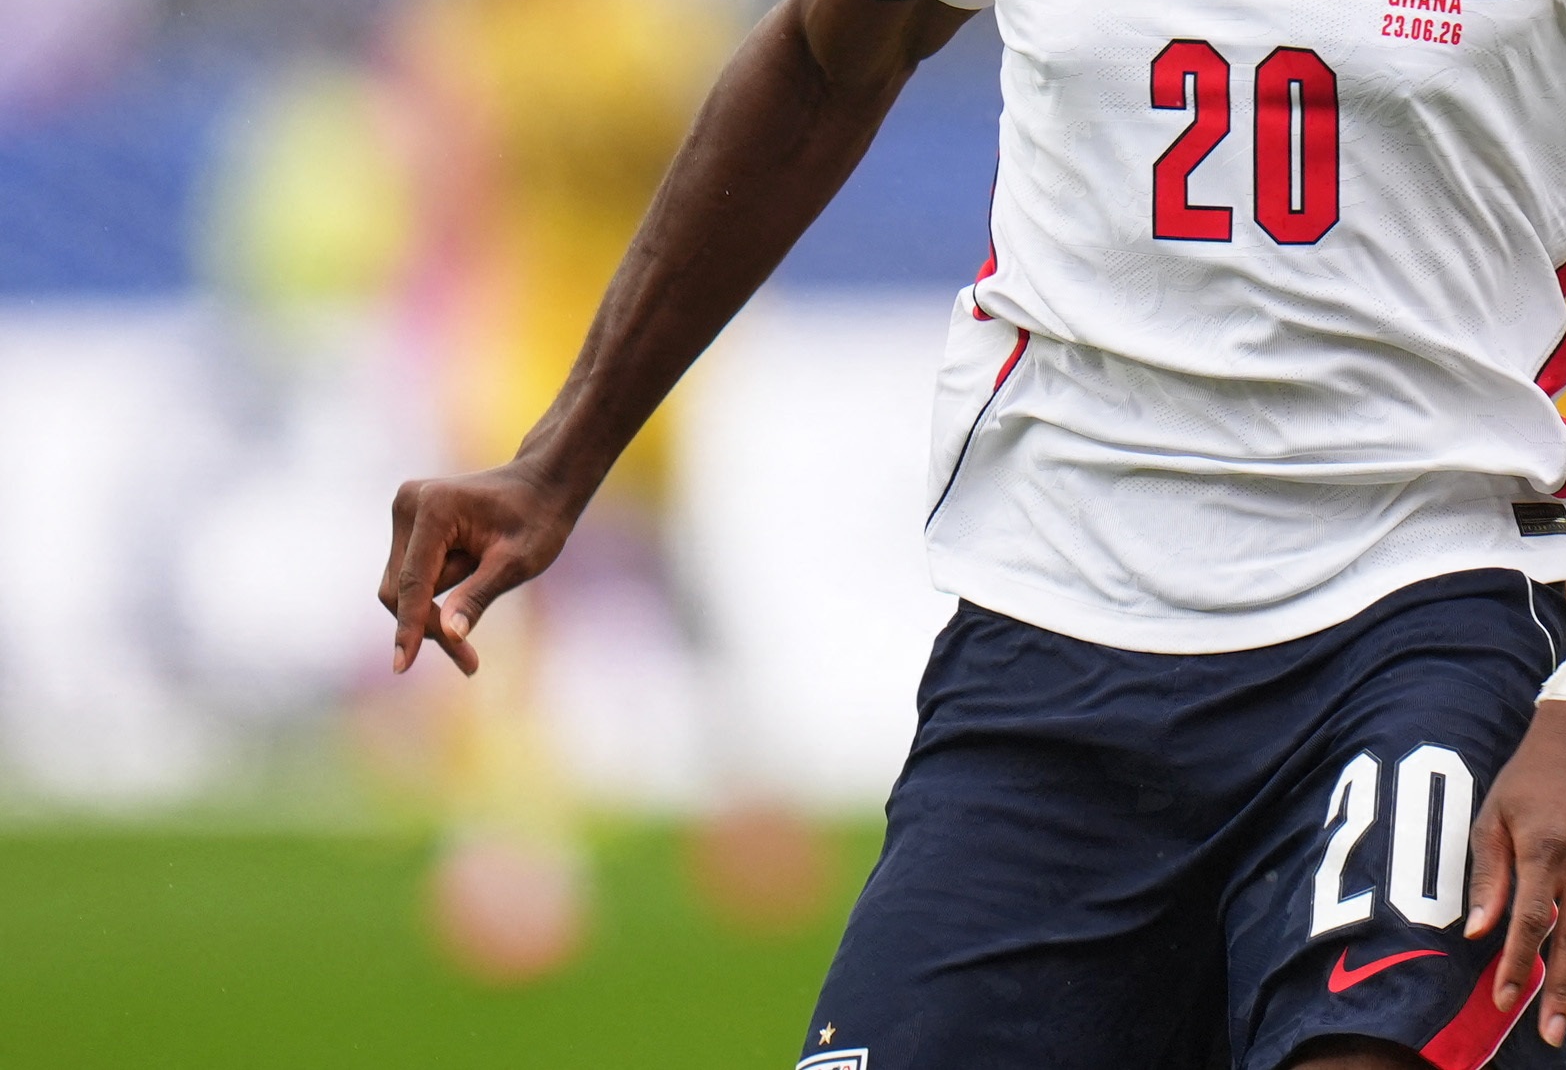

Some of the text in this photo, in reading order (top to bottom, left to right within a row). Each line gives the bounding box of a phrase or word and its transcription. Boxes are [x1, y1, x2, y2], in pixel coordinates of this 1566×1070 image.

[1381, 14, 1463, 45] 23.06.26
[1150, 38, 1341, 246] 20
[1308, 741, 1477, 934] 20
